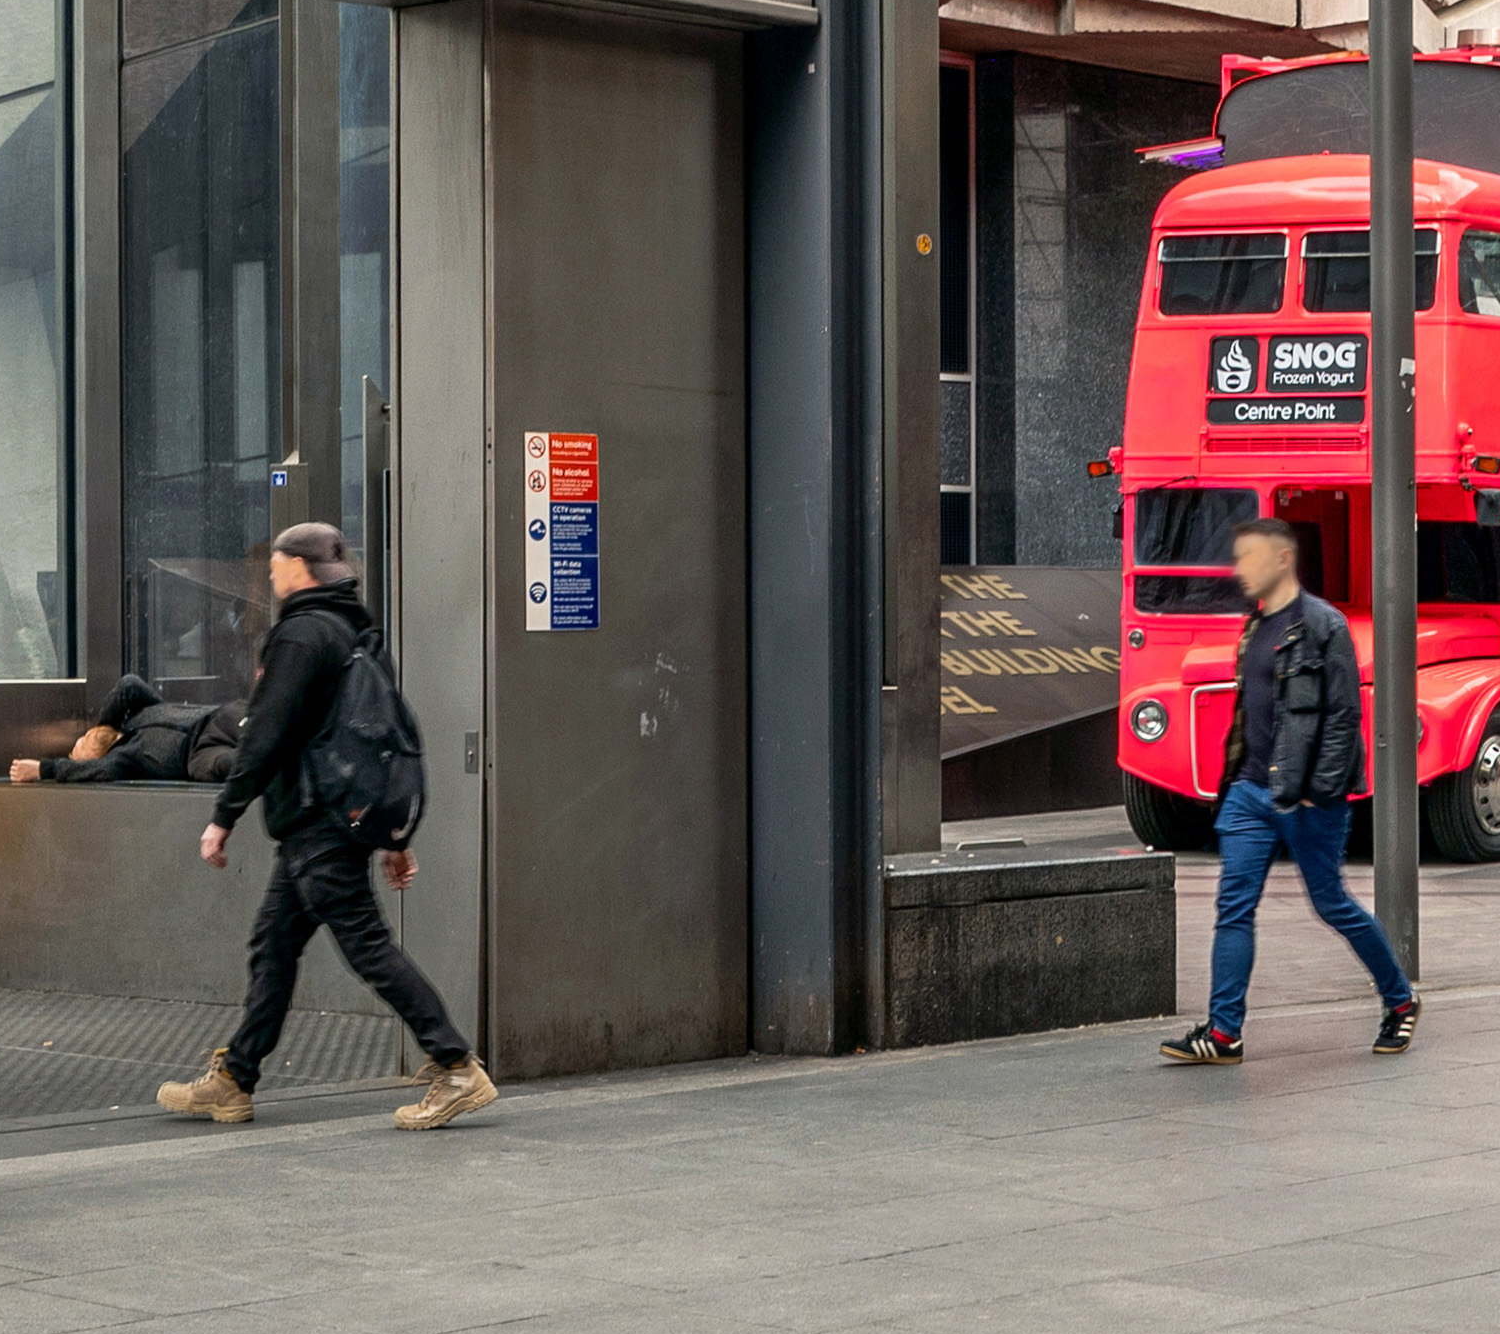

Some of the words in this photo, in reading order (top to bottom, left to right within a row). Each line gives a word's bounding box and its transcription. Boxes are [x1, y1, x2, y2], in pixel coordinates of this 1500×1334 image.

[1273, 341, 1357, 370] SNOG
[1272, 371, 1315, 385] Frozen
[1316, 371, 1355, 386] Yogurt
[1235, 403, 1293, 421] Centre
[1294, 402, 1336, 421] Point
[551, 439, 563, 448] No
[552, 468, 564, 476] No
